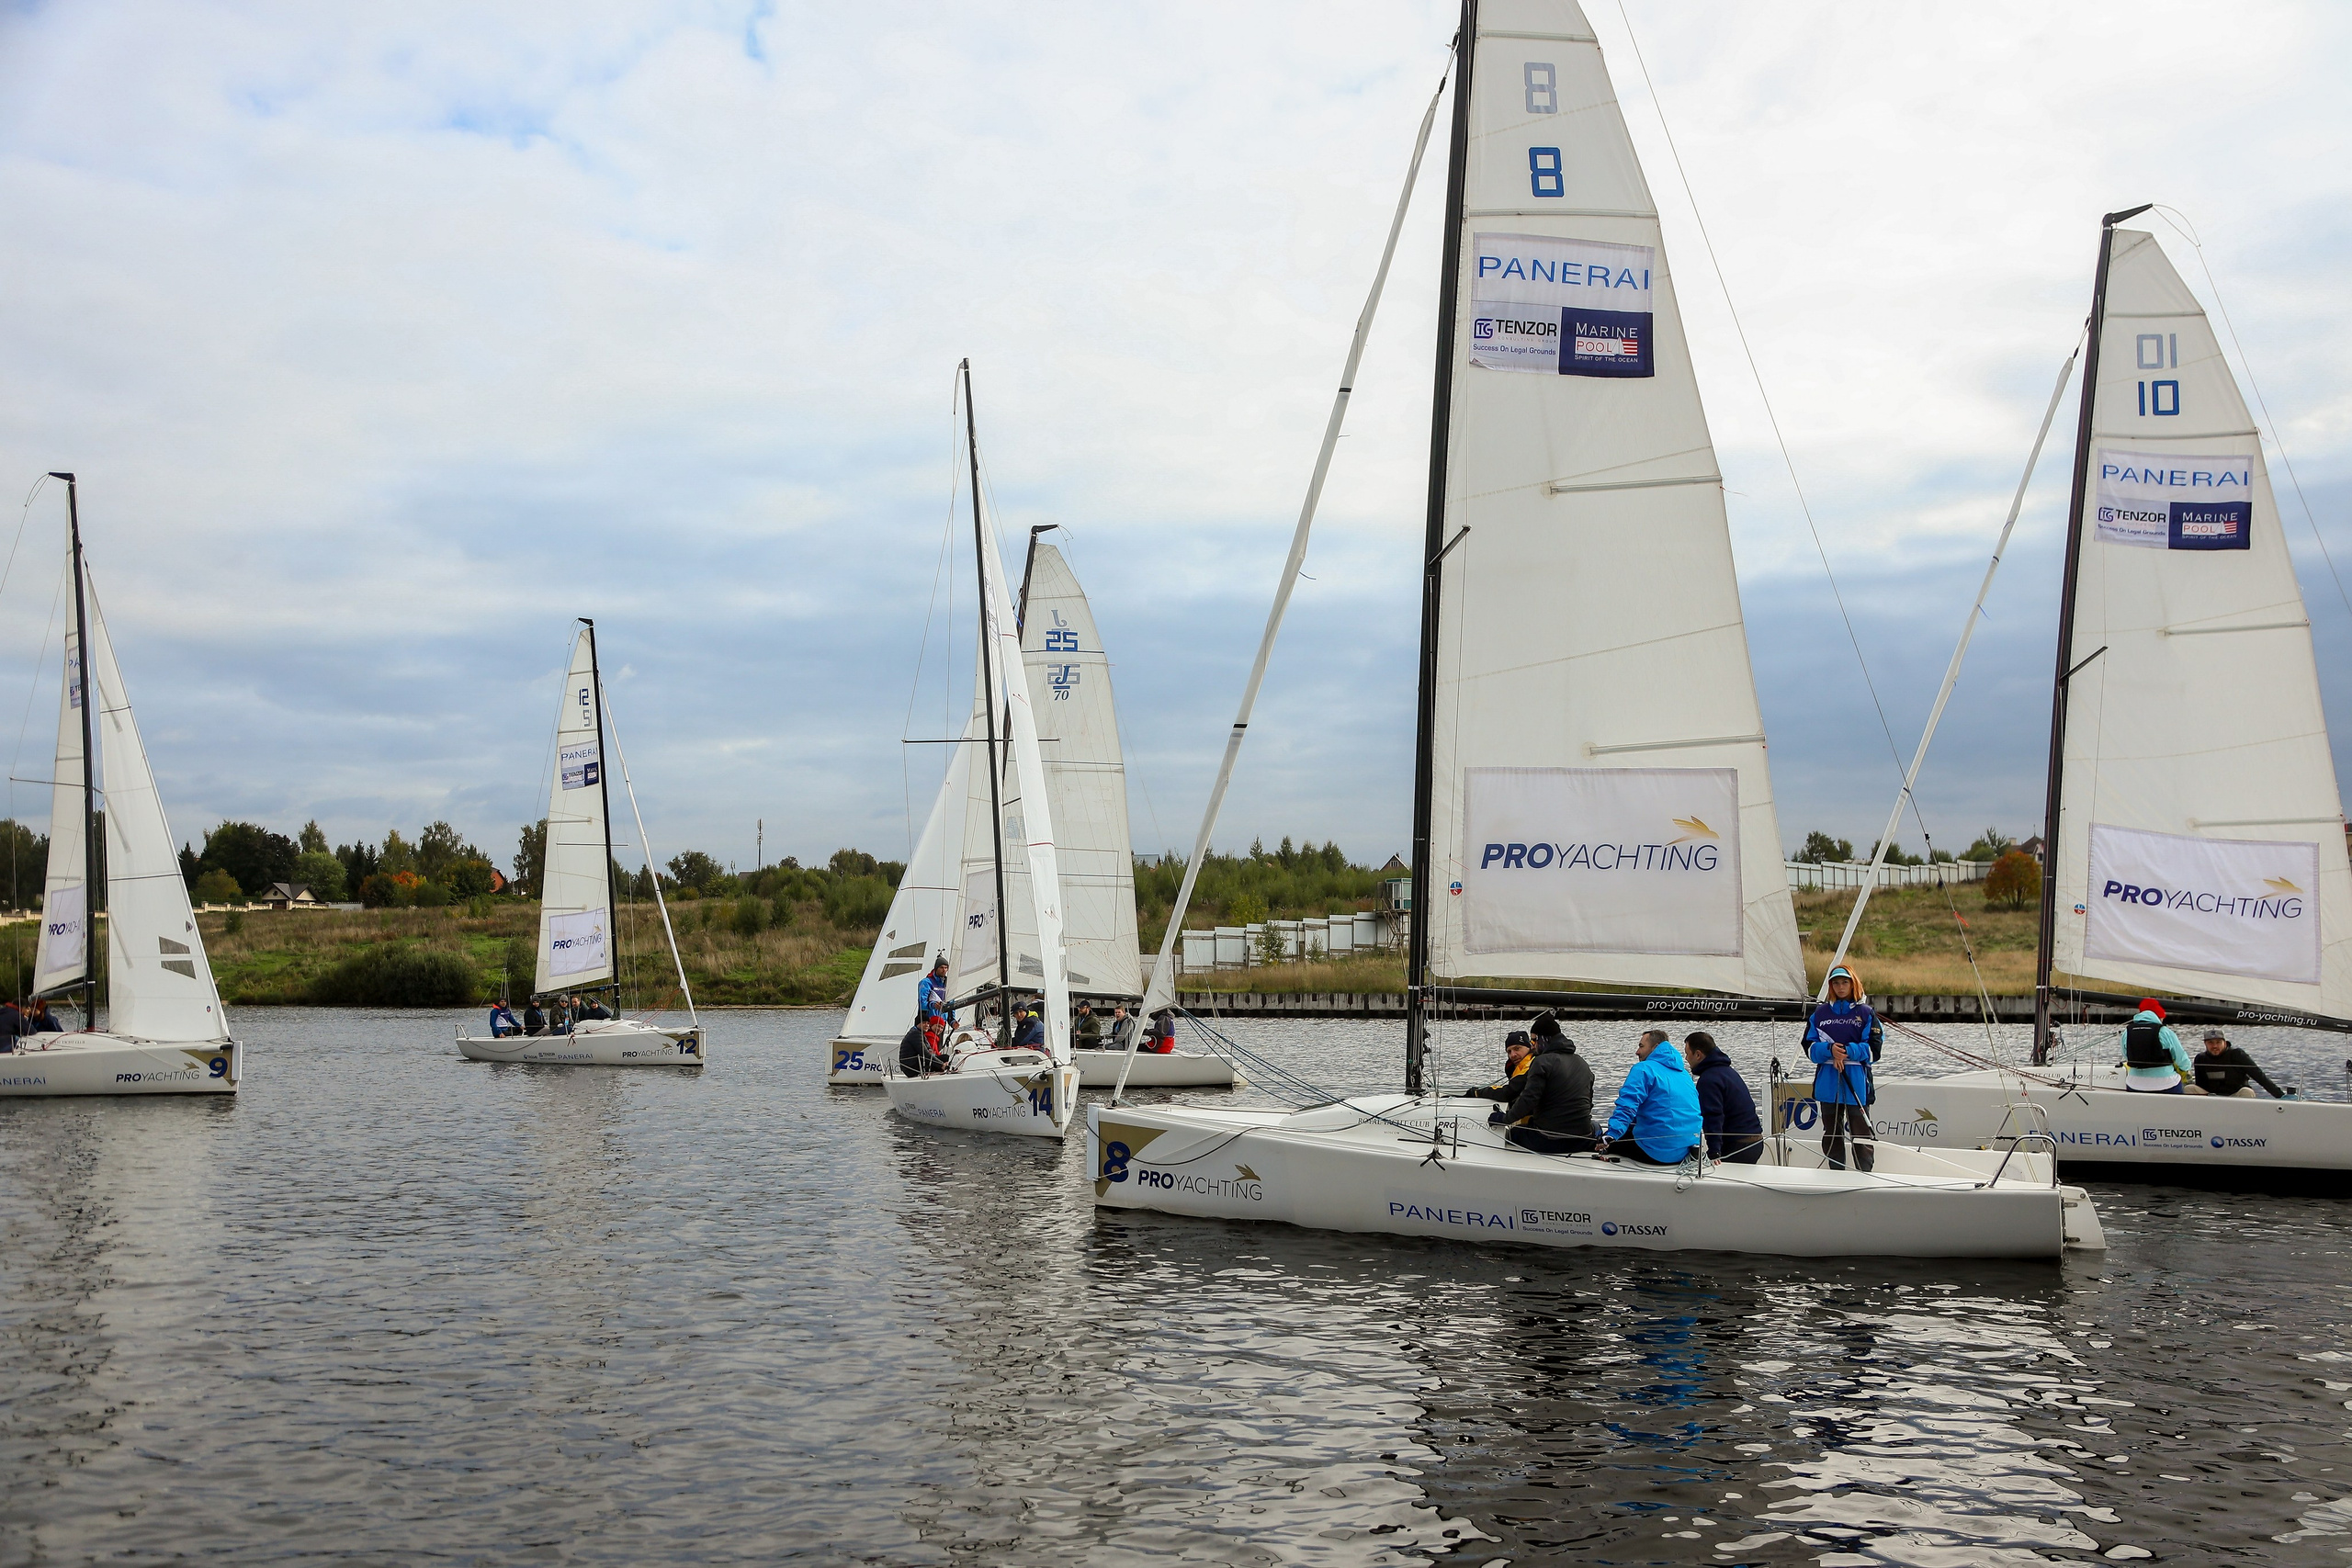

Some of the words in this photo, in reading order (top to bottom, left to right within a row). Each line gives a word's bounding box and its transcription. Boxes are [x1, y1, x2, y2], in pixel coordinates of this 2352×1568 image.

[1523, 62, 1558, 114] 8
[1528, 147, 1565, 197] 8
[1478, 256, 1649, 290] PANERAI
[1496, 319, 1557, 337] TENZOR
[1473, 344, 1499, 352] Success
[1510, 346, 1528, 355] Legal
[1529, 346, 1556, 355] Grounds
[1577, 340, 1612, 353] POOL
[2137, 379, 2180, 417] 10
[2102, 464, 2249, 488] PANERAI
[2116, 509, 2166, 524] TENZOR
[2183, 524, 2216, 534] POOL
[1046, 630, 1079, 651] 25
[579, 688, 590, 706] 12
[1054, 690, 1069, 701] 70
[1480, 842, 1718, 872] PROYACHTING
[2102, 879, 2304, 919] PROYACHTING
[552, 933, 602, 950] PROYACHTING
[1645, 999, 1738, 1012] pro-yachting.ru
[2236, 1009, 2318, 1027] pro-yachting.ru
[622, 1048, 673, 1058] PROYACHTING
[676, 1038, 697, 1055] 12
[209, 1056, 229, 1079] 9
[834, 1050, 865, 1071] 25
[0, 1077, 47, 1086] NERAI
[115, 1069, 200, 1083] PROYACHTING
[1027, 1087, 1053, 1117] 14
[972, 1105, 1026, 1119] PROYACHTING
[1780, 1097, 1818, 1131] 10
[1409, 1120, 1430, 1128] CLUB
[2157, 1129, 2202, 1138] TENZOR
[2226, 1138, 2267, 1147] TASSAY
[1102, 1140, 1131, 1183] 8
[1137, 1168, 1263, 1201] PROYACHTING
[1389, 1201, 1514, 1230] PANERAI
[1539, 1210, 1592, 1224] TENZOR
[1619, 1224, 1668, 1236] TASSAY
